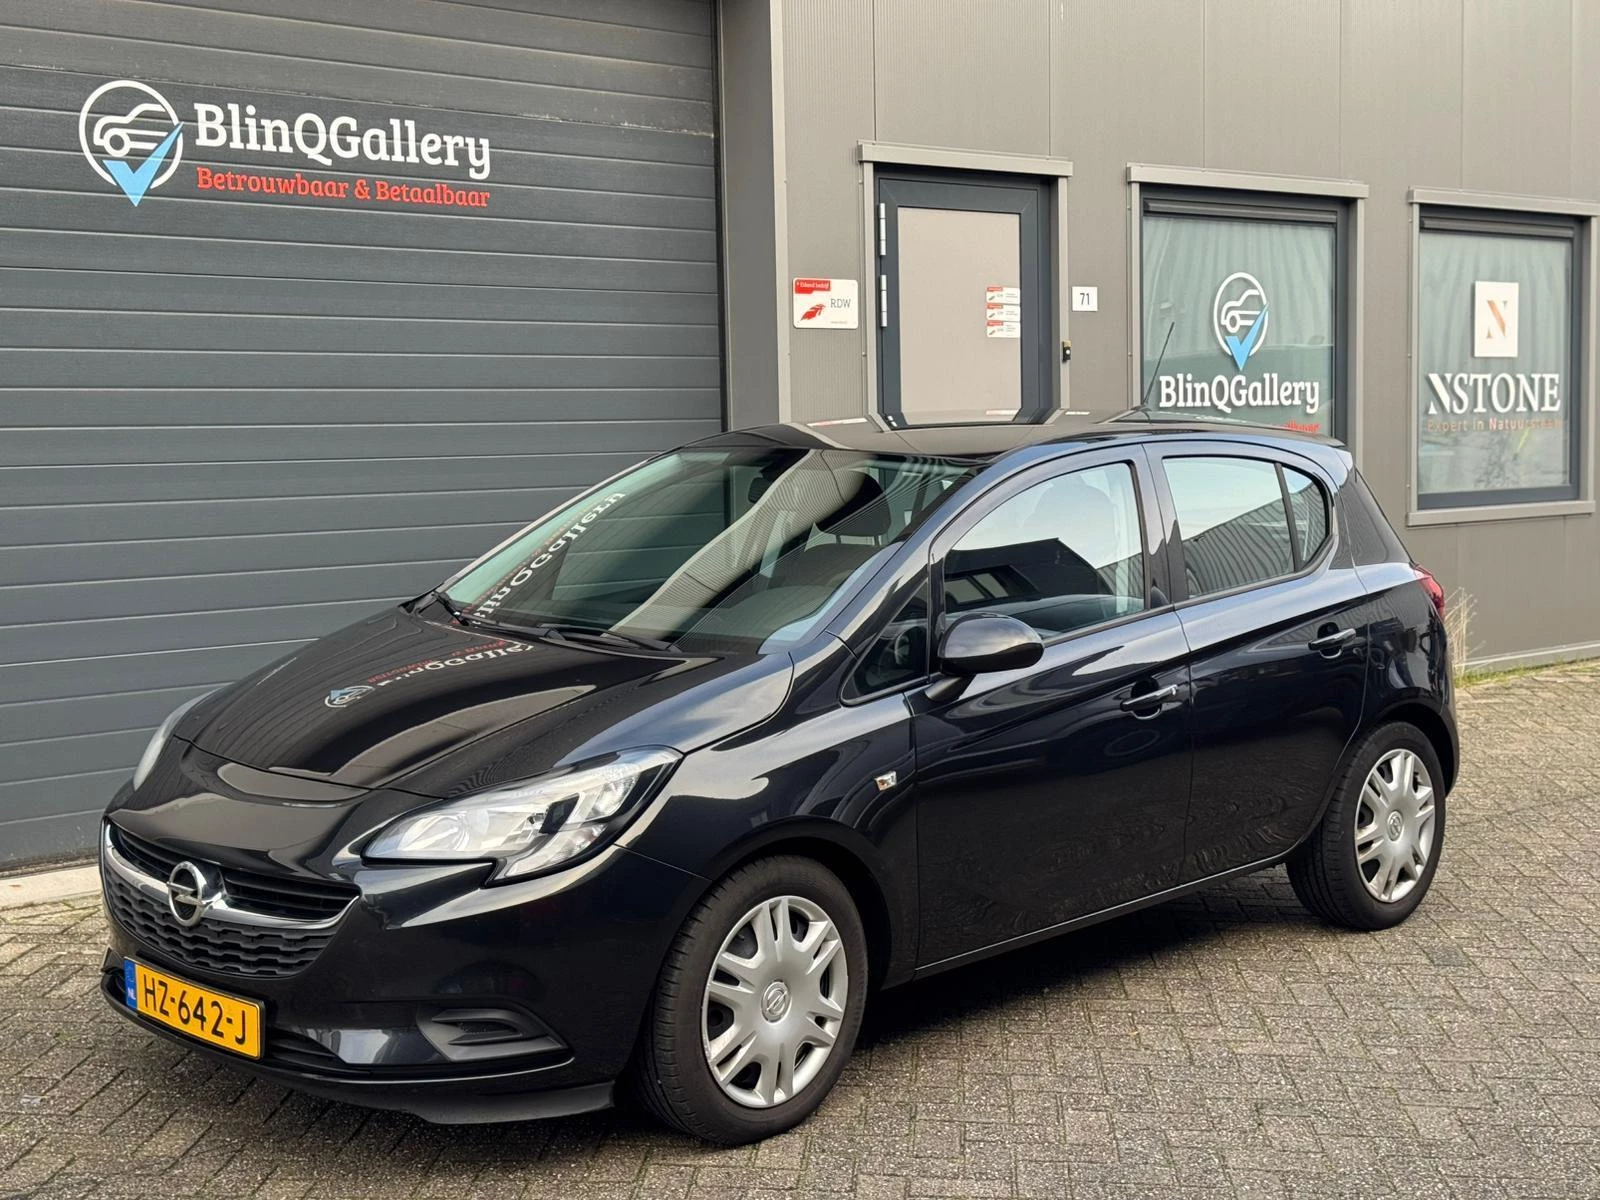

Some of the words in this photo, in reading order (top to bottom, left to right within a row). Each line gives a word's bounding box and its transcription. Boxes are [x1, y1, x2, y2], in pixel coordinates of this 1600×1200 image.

[194, 102, 491, 180] BlinQGallery
[196, 166, 349, 199] Betrouwbaar
[354, 178, 371, 200] &
[375, 180, 491, 208] Betaalbaar
[830, 298, 851, 309] RDW
[1079, 292, 1090, 305] 71
[1159, 372, 1320, 414] BlinQGallery
[1427, 372, 1562, 415] NSTONE
[1426, 418, 1468, 433] Expert
[143, 974, 246, 1045] HZ-642-J
